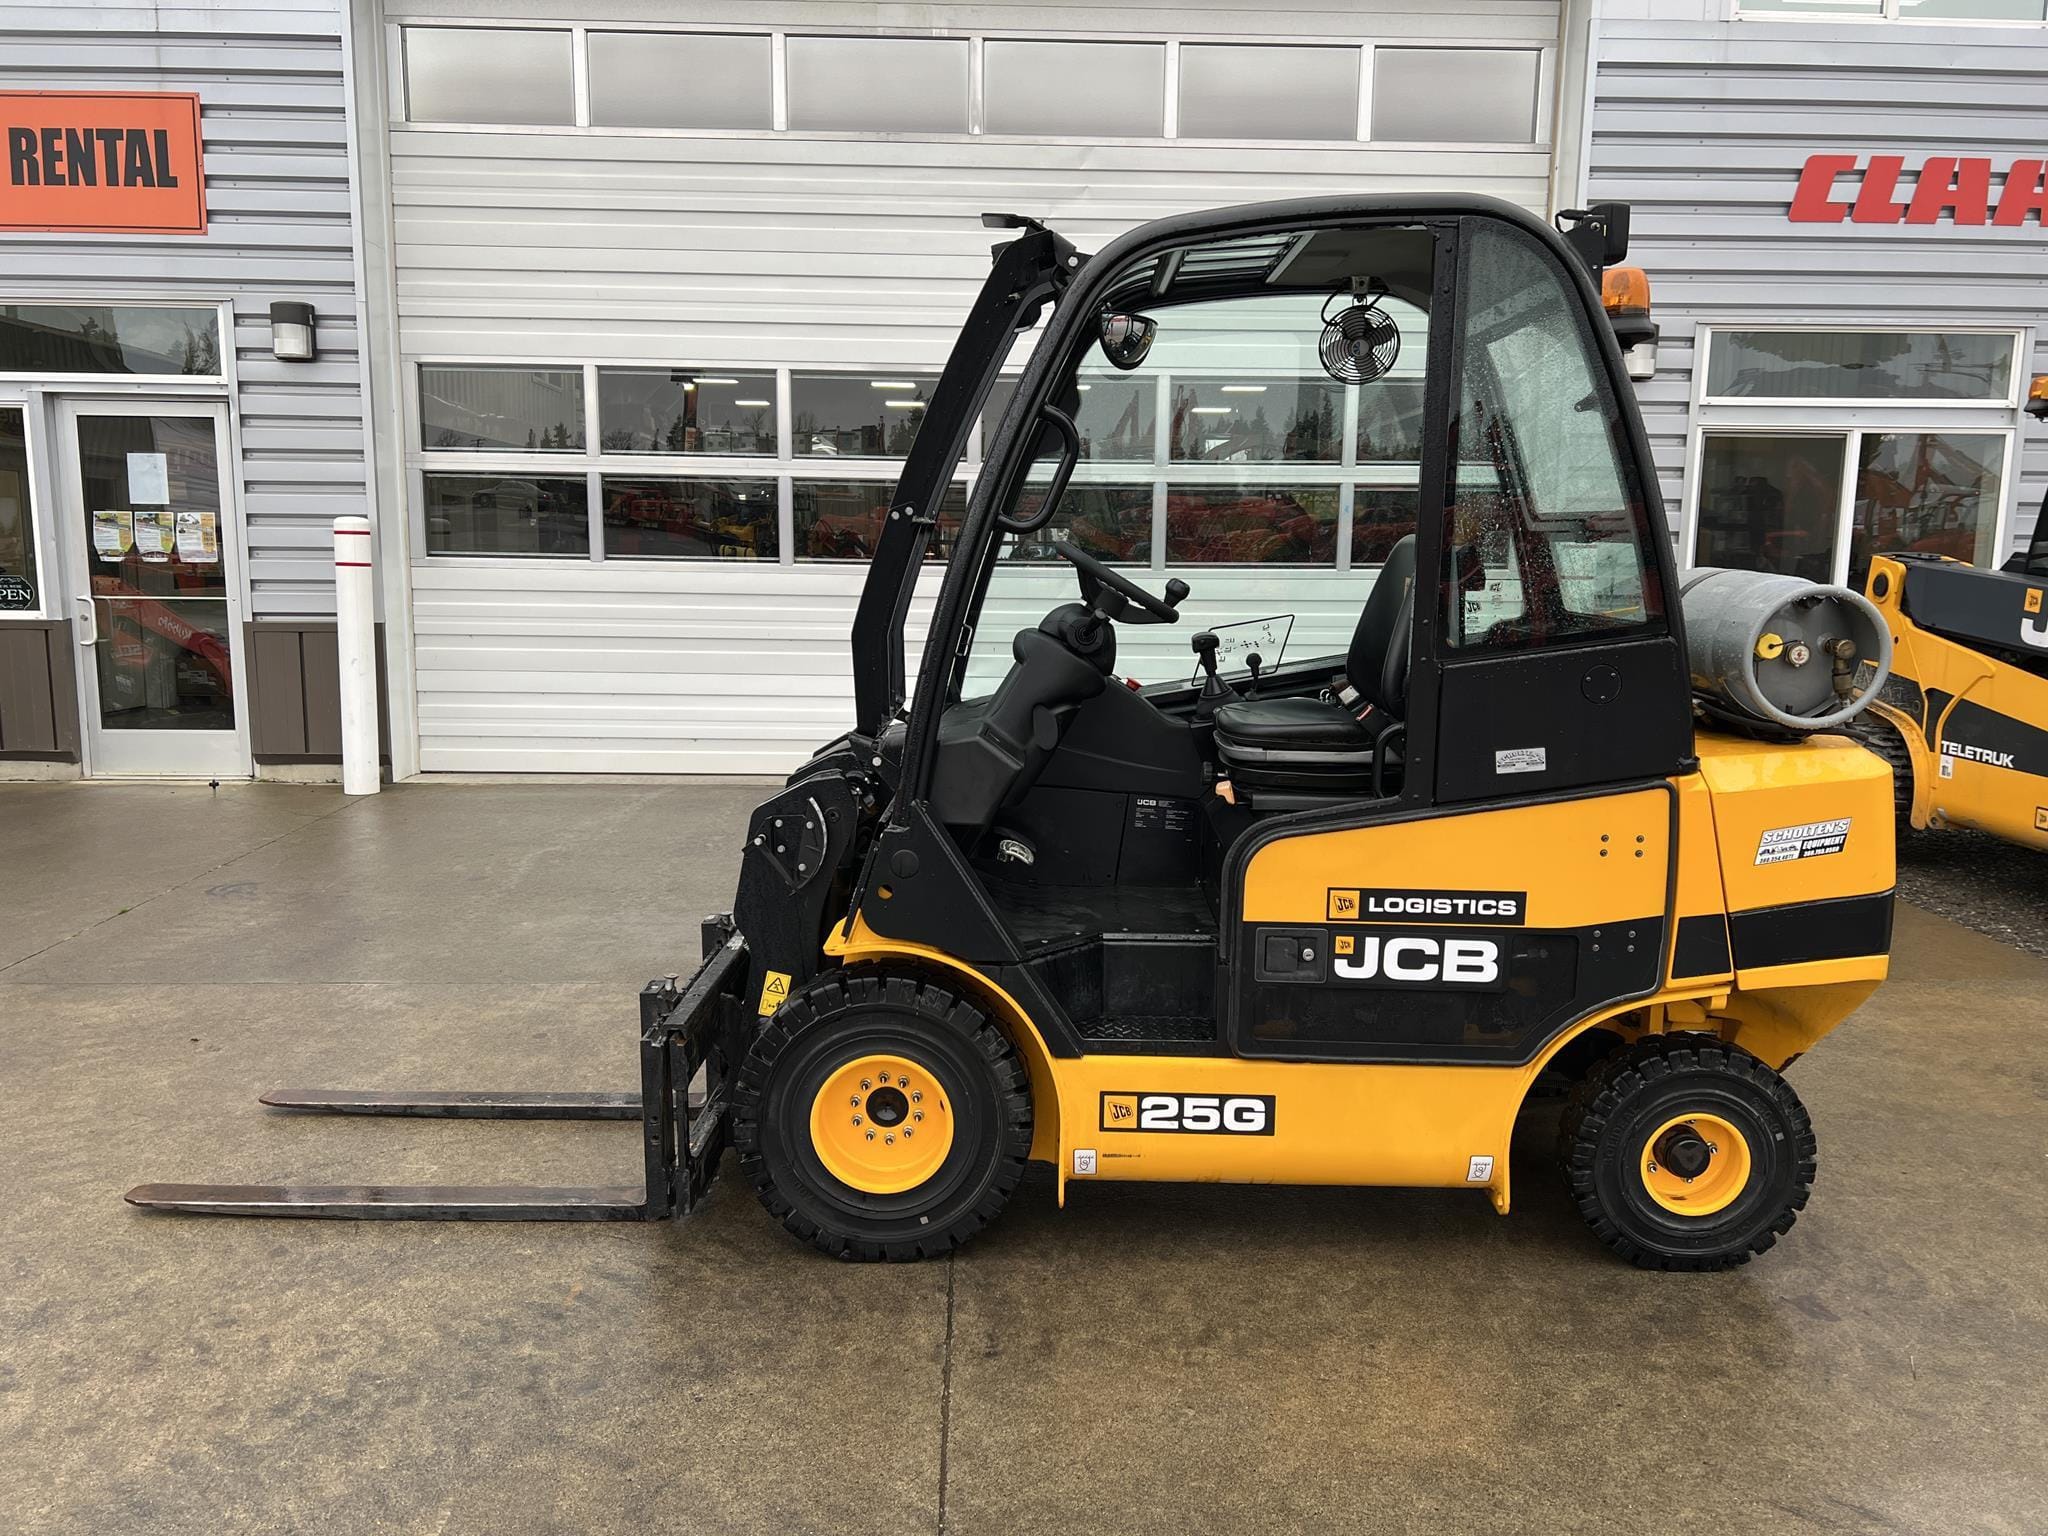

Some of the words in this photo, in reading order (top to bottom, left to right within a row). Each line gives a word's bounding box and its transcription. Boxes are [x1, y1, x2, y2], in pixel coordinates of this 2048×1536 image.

[8, 127, 178, 188] RENTAL
[1788, 154, 2048, 227] CLAA
[1941, 740, 2015, 768] TELETRUK
[1763, 820, 1849, 844] SCHOLTEN'S
[1803, 834, 1846, 850] EQUIPMENT
[1335, 896, 1354, 912] JCB
[1368, 897, 1517, 916] LOGISTICS
[1334, 936, 1499, 983] JCB
[1110, 1103, 1133, 1120] JCB
[1140, 1096, 1266, 1132] 25G
